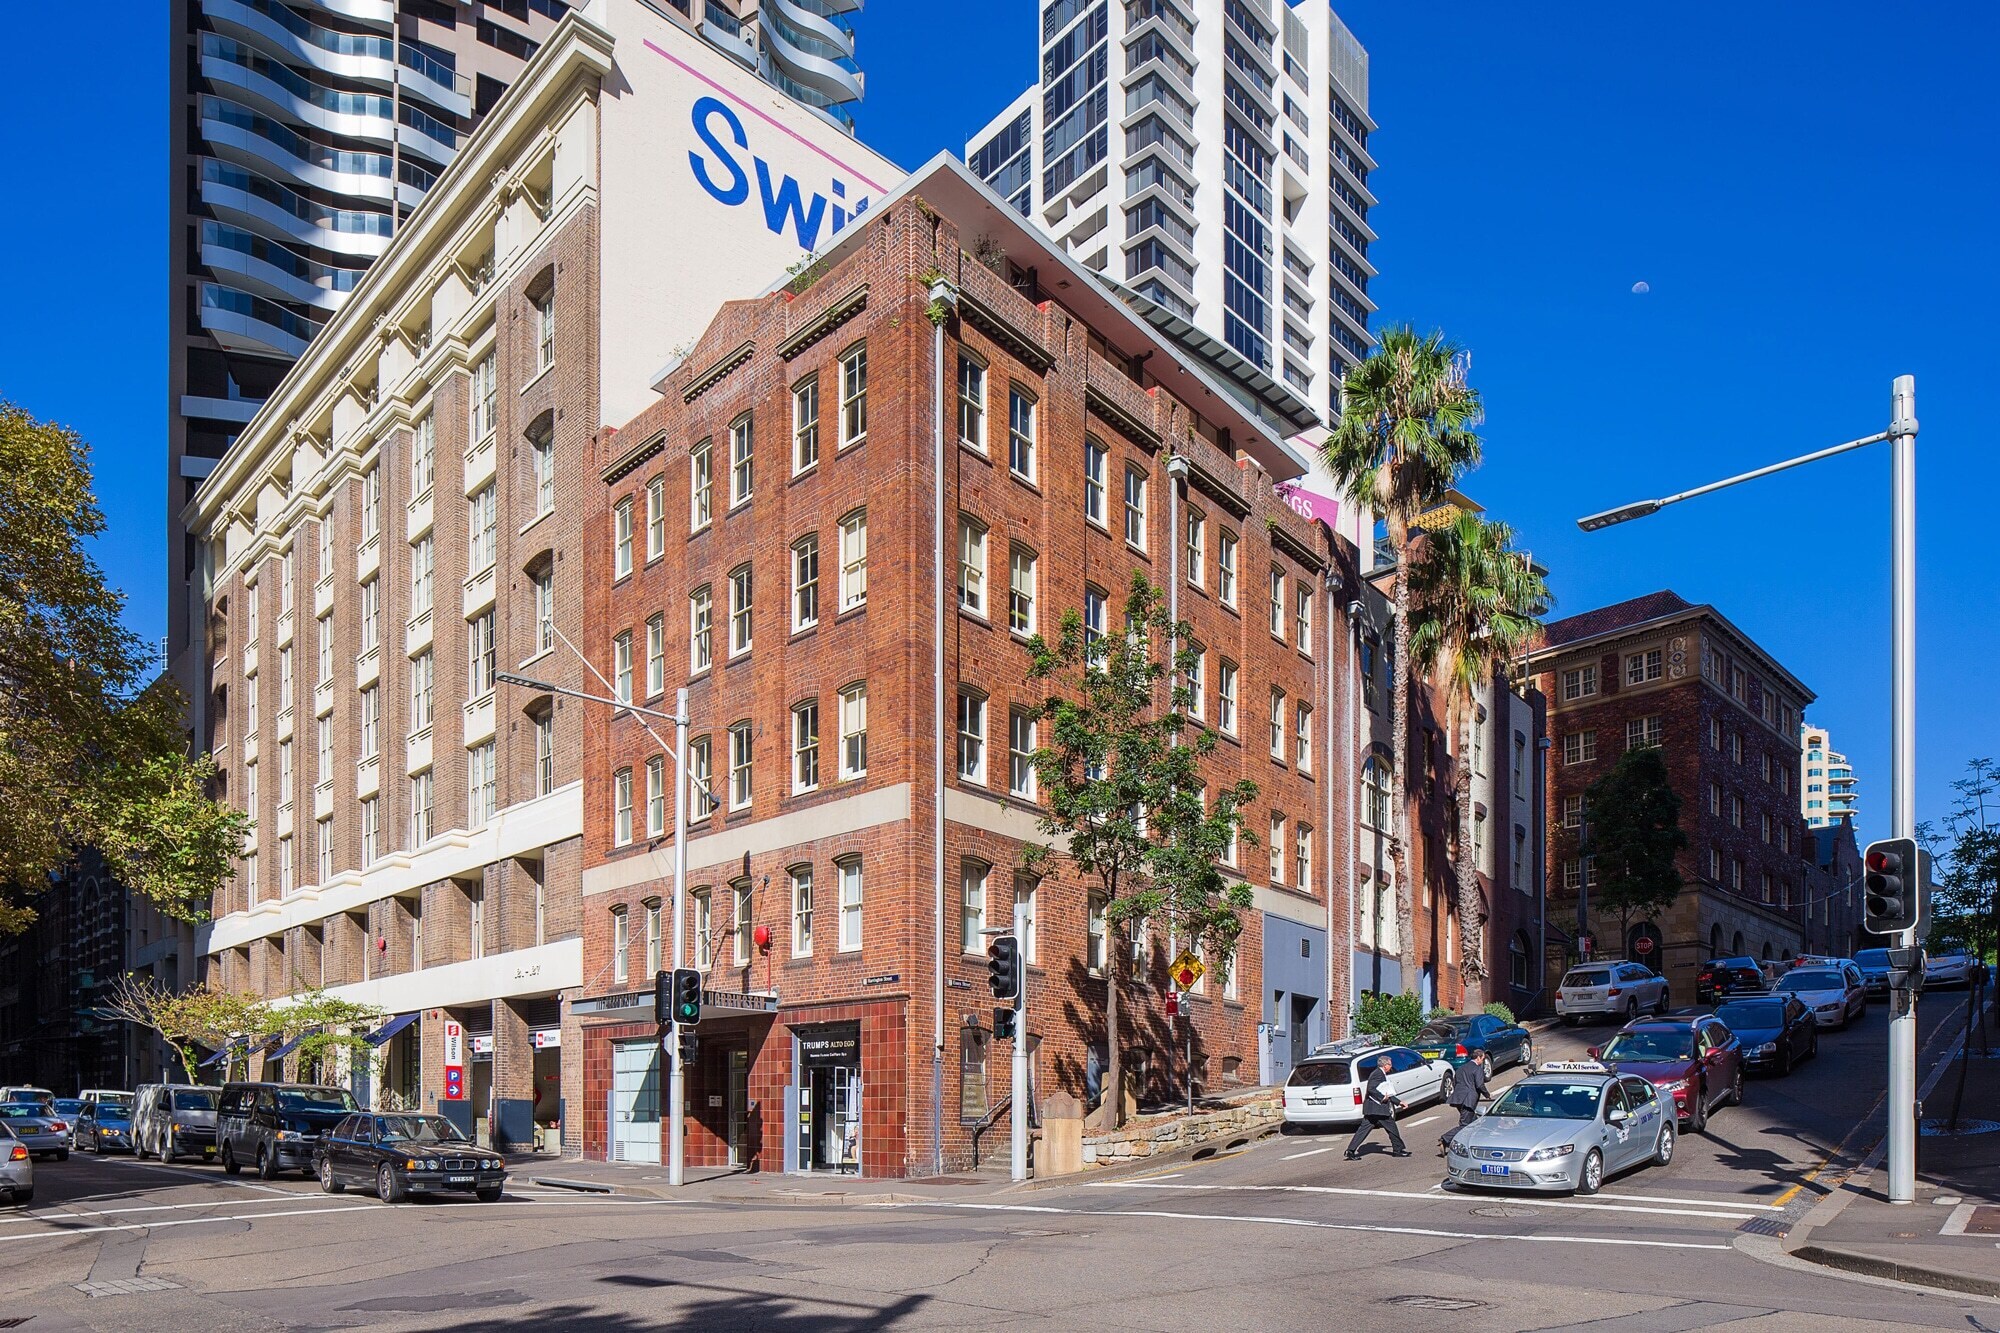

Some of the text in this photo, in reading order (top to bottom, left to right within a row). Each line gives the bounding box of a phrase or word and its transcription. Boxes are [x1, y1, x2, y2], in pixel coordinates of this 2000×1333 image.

[688, 96, 868, 252] Swi
[709, 991, 765, 1010] HARRINGTON
[802, 1041, 830, 1050] TRUMPS
[450, 1072, 458, 1081] P
